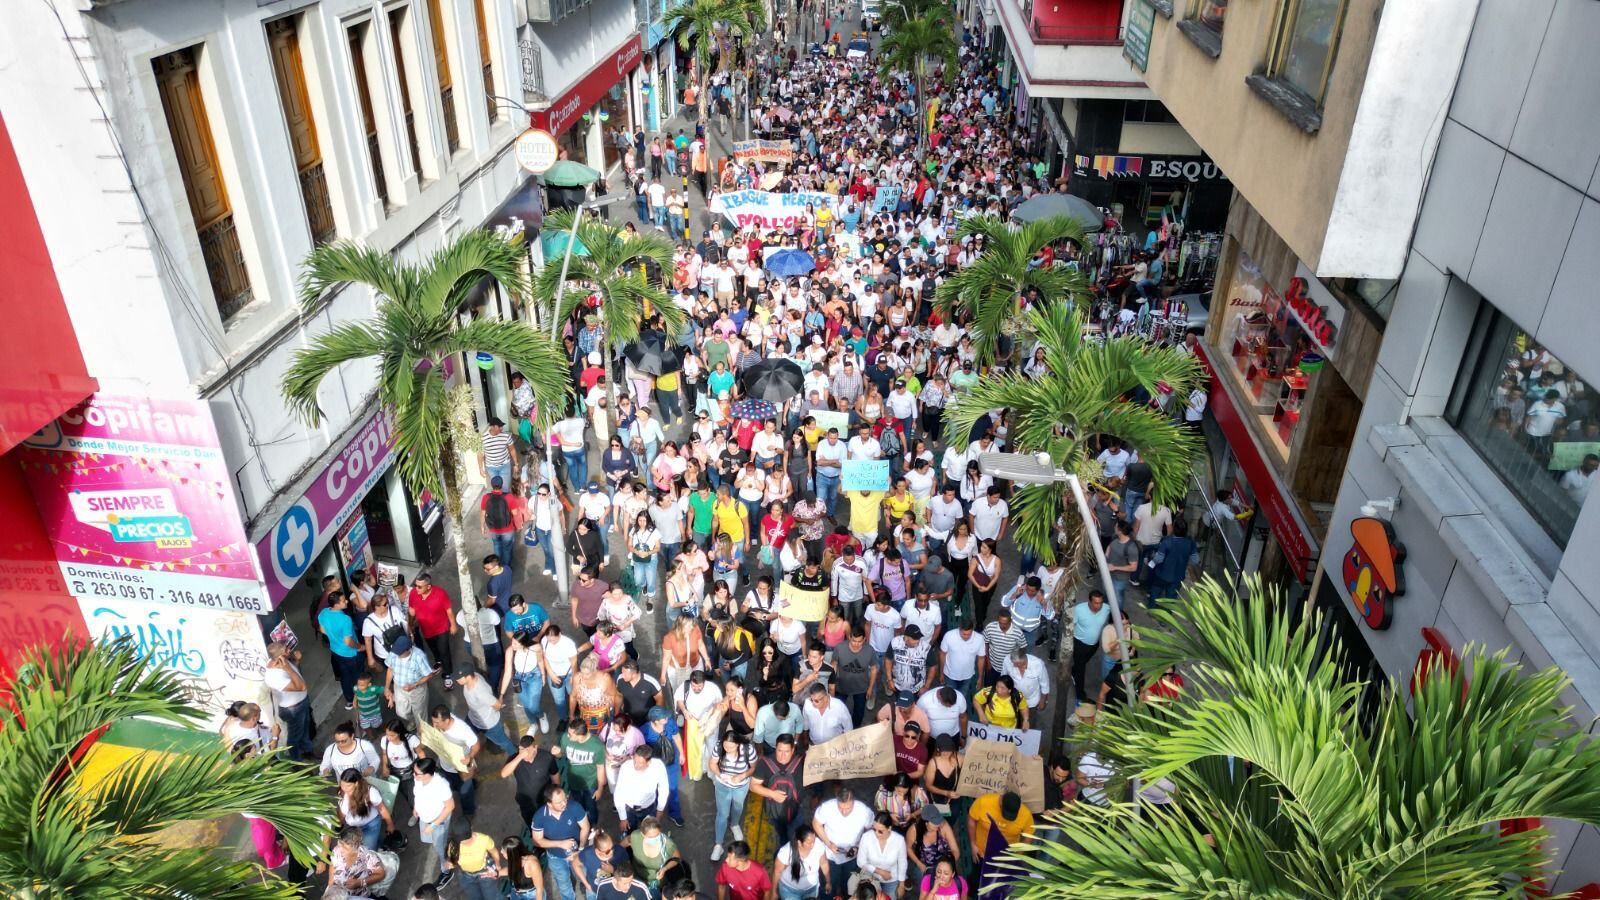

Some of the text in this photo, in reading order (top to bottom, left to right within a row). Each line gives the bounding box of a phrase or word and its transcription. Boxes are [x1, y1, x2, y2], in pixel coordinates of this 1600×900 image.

[519, 142, 555, 154] HOTEL
[721, 189, 831, 209] IBAGUE MERECE
[68, 438, 104, 450] Donde
[107, 442, 140, 454] Mejor
[142, 444, 191, 458] Servicio
[87, 494, 165, 513] SIEMPRE
[335, 492, 363, 528] Donde
[363, 462, 387, 493] Mejor
[116, 521, 186, 539] PRECIOS
[161, 538, 188, 547] BAJOS
[66, 566, 145, 584] Domicilios:
[91, 581, 117, 598] 263
[119, 584, 137, 599] 09
[140, 587, 155, 601] 67
[170, 589, 195, 606] 316
[198, 592, 223, 608] 481
[227, 595, 262, 612] 1665
[969, 727, 987, 741] NO
